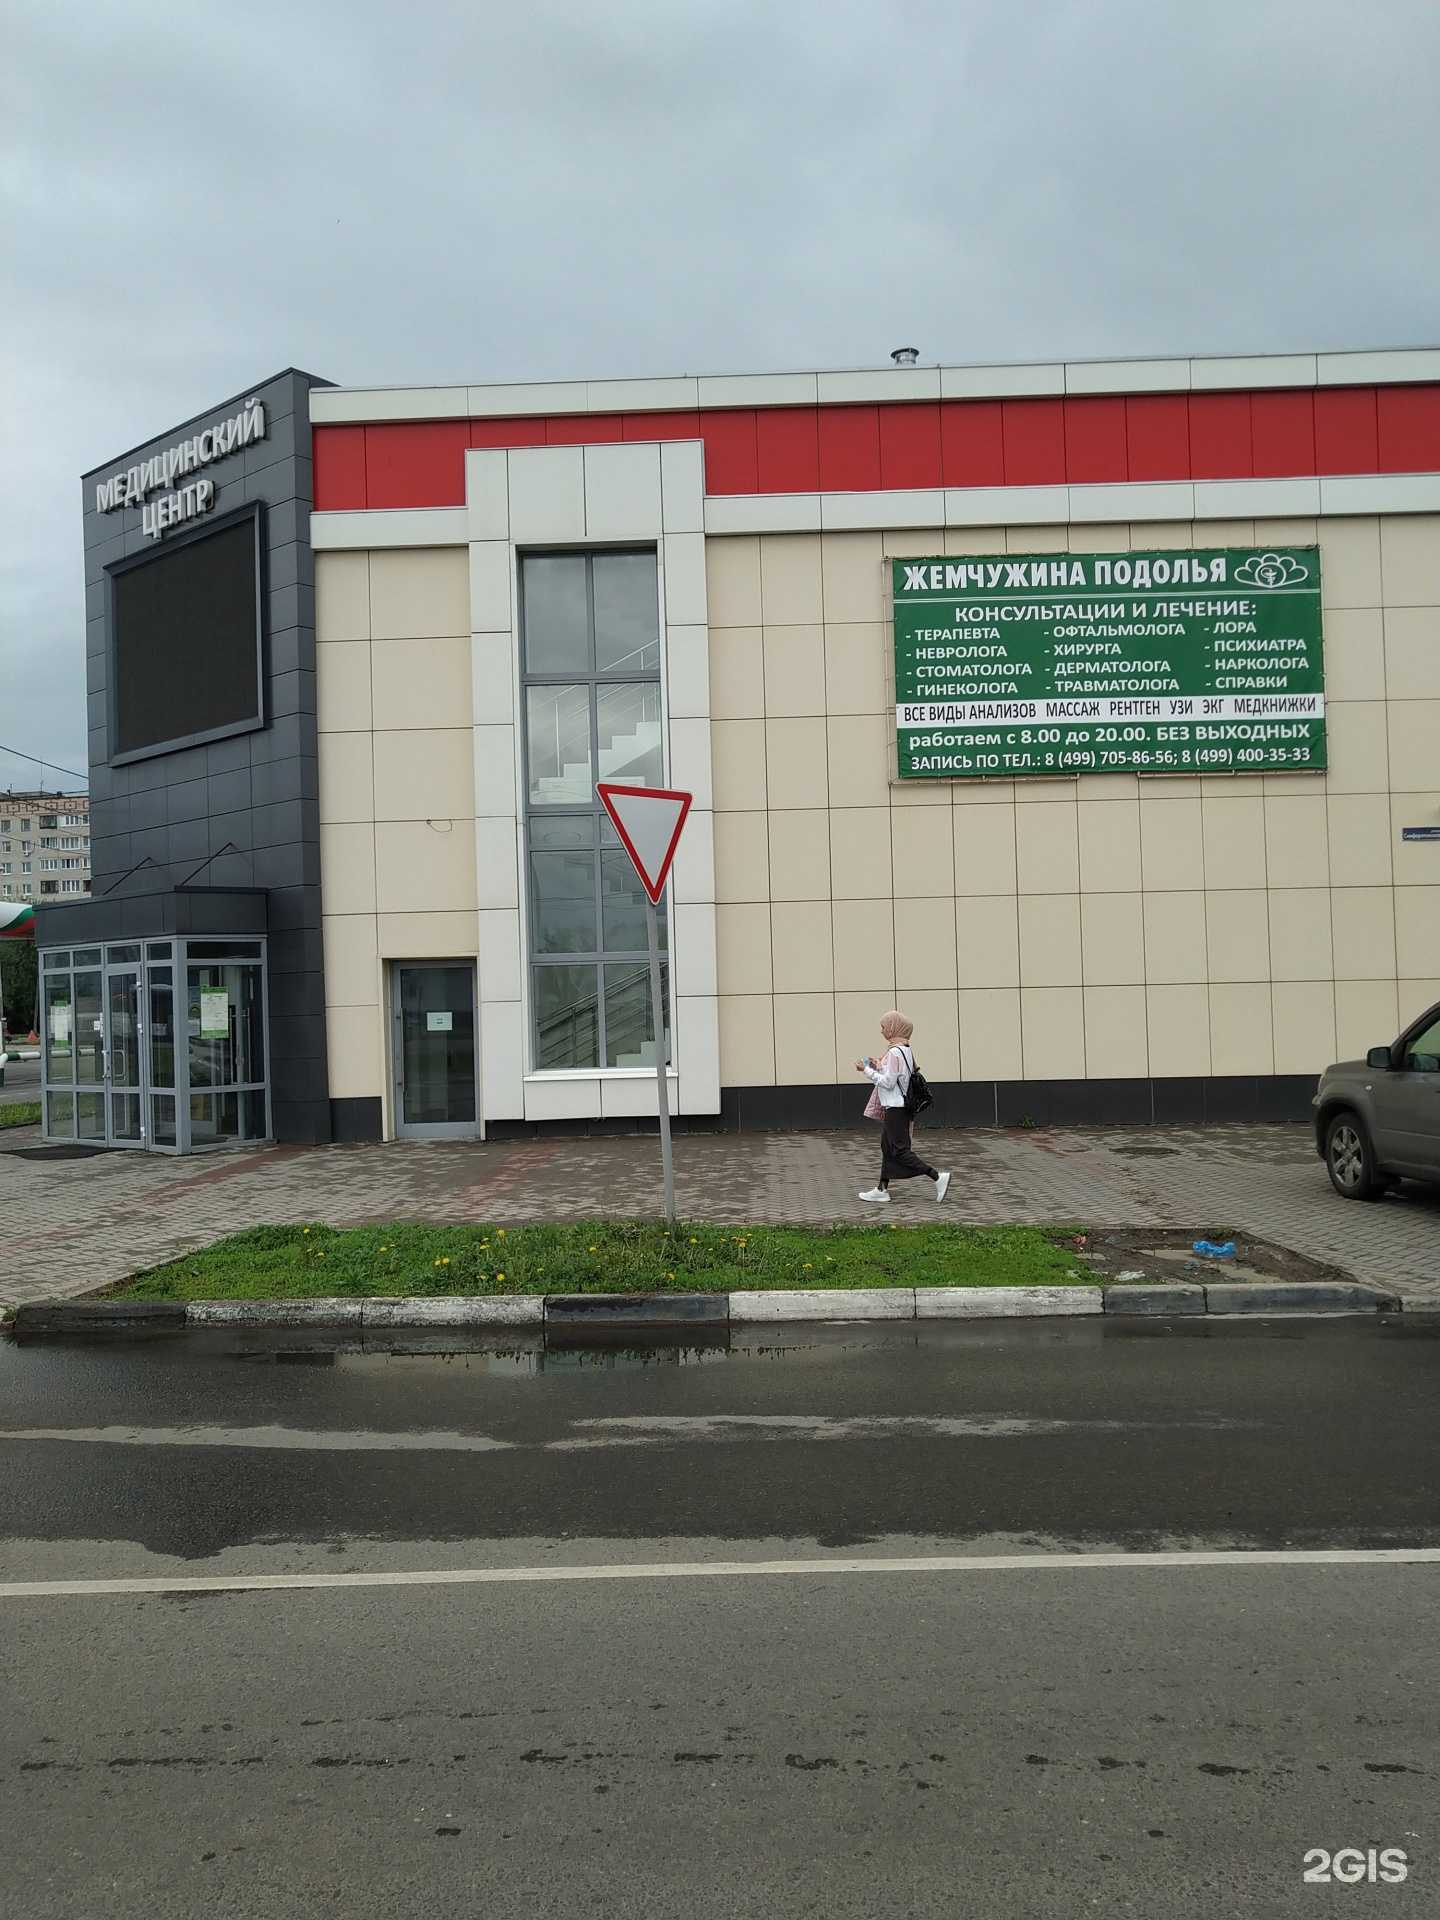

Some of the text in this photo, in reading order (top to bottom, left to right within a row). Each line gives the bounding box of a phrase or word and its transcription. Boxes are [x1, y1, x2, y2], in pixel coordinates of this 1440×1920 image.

[96, 397, 266, 514] МЕДИЦИНСКИЙ
[142, 479, 214, 539] ЦЕНТР
[903, 558, 1227, 590] ЖЕМЧУЖИНА ПОДОЛЬЯ
[955, 600, 1257, 622] КОНСУЛЬТАЦИИ И ЛЕЧЕНИЕ:
[915, 627, 1000, 641] ТЕРАПЕВТА
[1053, 624, 1186, 638] ОФТАЛЬМОЛОГА
[1213, 622, 1257, 634] ЛОРА
[915, 645, 1007, 659] НЕВРОЛОГА
[1054, 643, 1122, 656] ХИРУРГА
[1214, 639, 1307, 652] ПСИХИАТРА
[916, 663, 1032, 678] СТОМАТОЛОГА
[1054, 660, 1171, 676] ДЕРМАТОЛОГА
[1215, 657, 1309, 671] НАРКОЛОГА
[916, 682, 1018, 696] ГИНЕКОЛОГА
[1055, 679, 1180, 692] ТРАВМАТОЛОГА
[1215, 676, 1288, 689] СПРАВКИ
[904, 697, 1316, 724] ВСЕ ВИДЫ АНАЛИЗОВ МАССАЖ РЕНТГЕН УЗИ ЭКГ МЕДКНИЖКИ
[909, 724, 1310, 750] работаем с 8.00 до 20.00. БЕЗ ВЫХОДНЫХ
[911, 754, 972, 770] ЗАПИСЬ
[976, 754, 999, 768] ПО
[1045, 752, 1054, 766] 8
[1058, 750, 1096, 768] (499)
[1100, 750, 1178, 766] 705-86-56;
[1182, 749, 1191, 763] 8
[1195, 748, 1233, 765] (499)
[1236, 747, 1310, 762] 400-35-33
